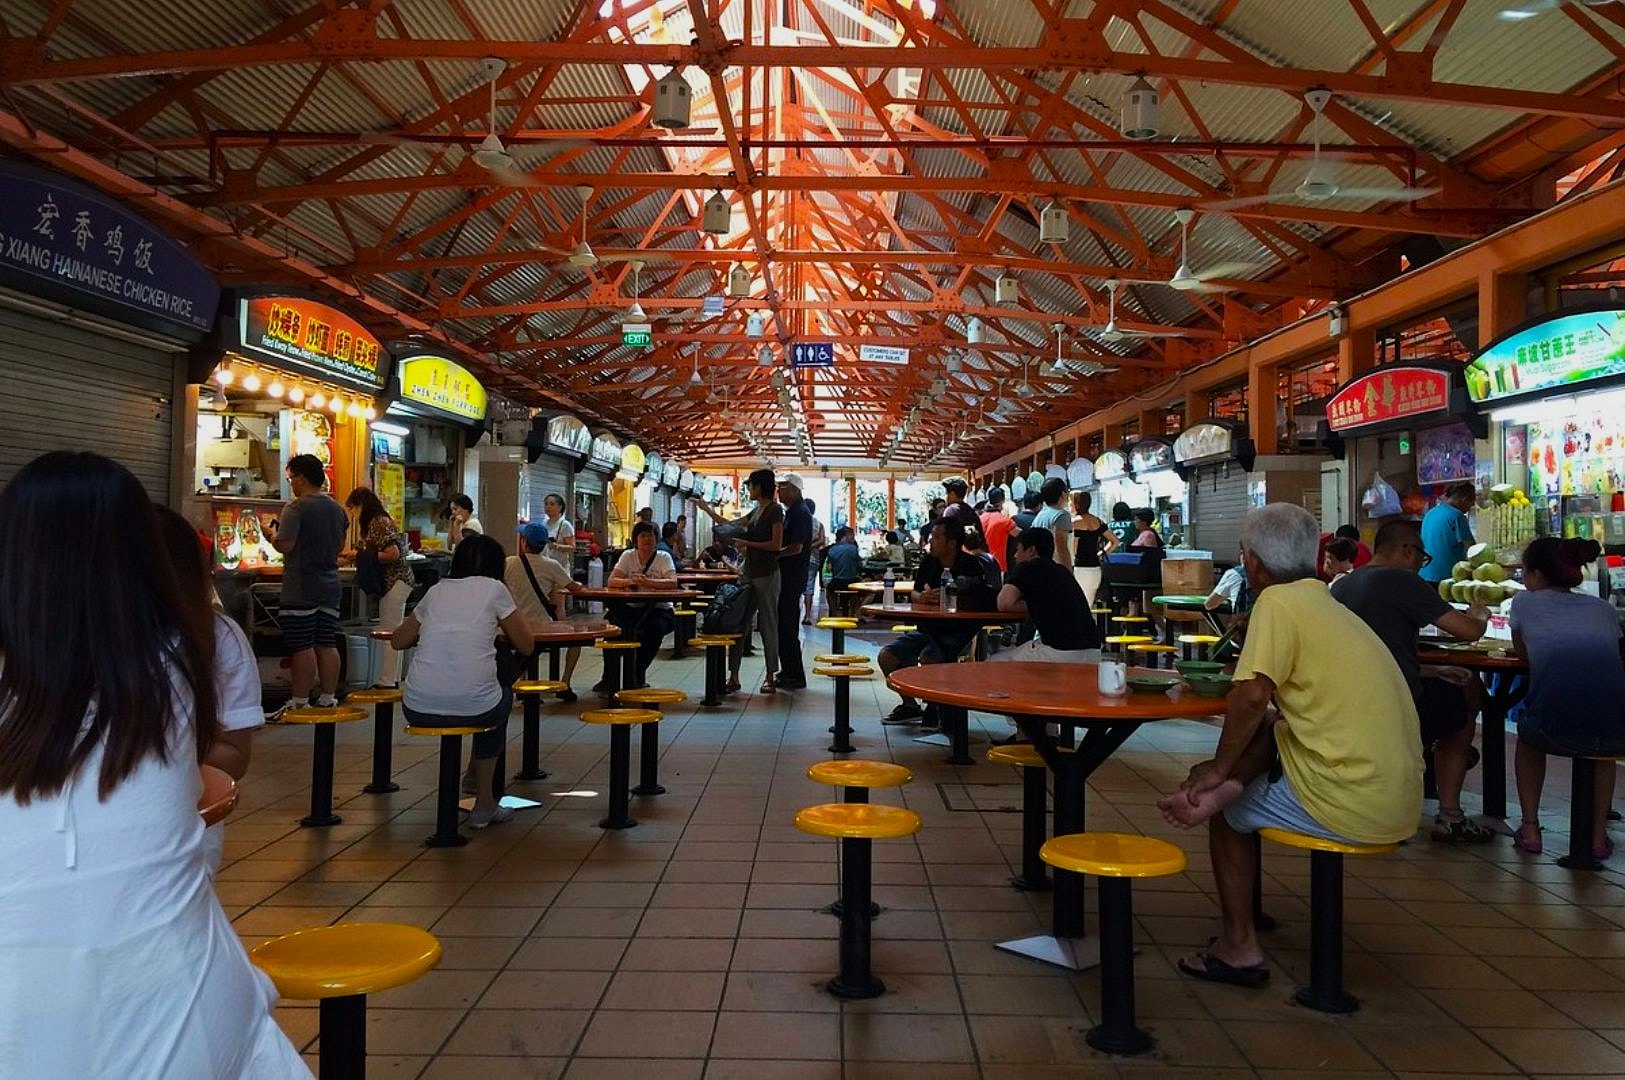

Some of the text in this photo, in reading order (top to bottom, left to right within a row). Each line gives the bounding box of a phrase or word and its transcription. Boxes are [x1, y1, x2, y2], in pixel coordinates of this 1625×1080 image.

[6, 236, 51, 270] XIANG
[52, 252, 123, 296] HAINANESE
[123, 278, 170, 311] CHICKEN
[169, 294, 193, 318] RICE
[627, 333, 645, 344] EXIT
[411, 384, 430, 397] ZHEN
[432, 391, 449, 403] ZHEN
